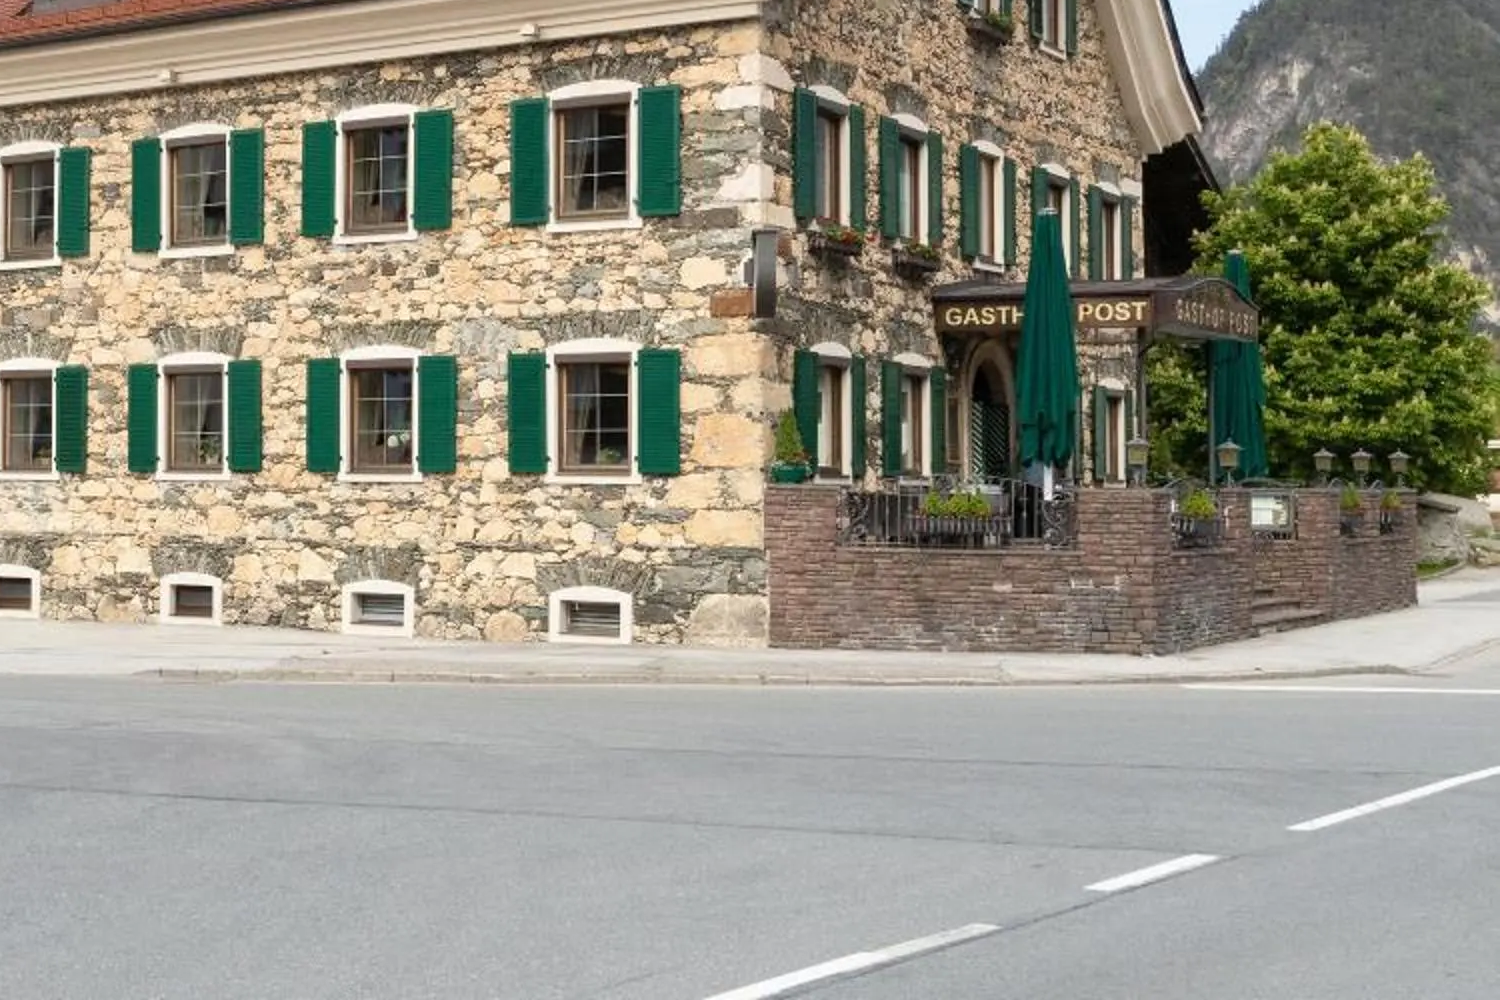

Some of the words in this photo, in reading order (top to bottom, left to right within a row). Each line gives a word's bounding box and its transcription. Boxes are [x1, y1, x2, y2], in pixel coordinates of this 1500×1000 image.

[945, 306, 1025, 326] GASTH
[1077, 301, 1147, 322] POST
[1175, 299, 1225, 328] GASTHOF
[1229, 311, 1255, 335] POST
